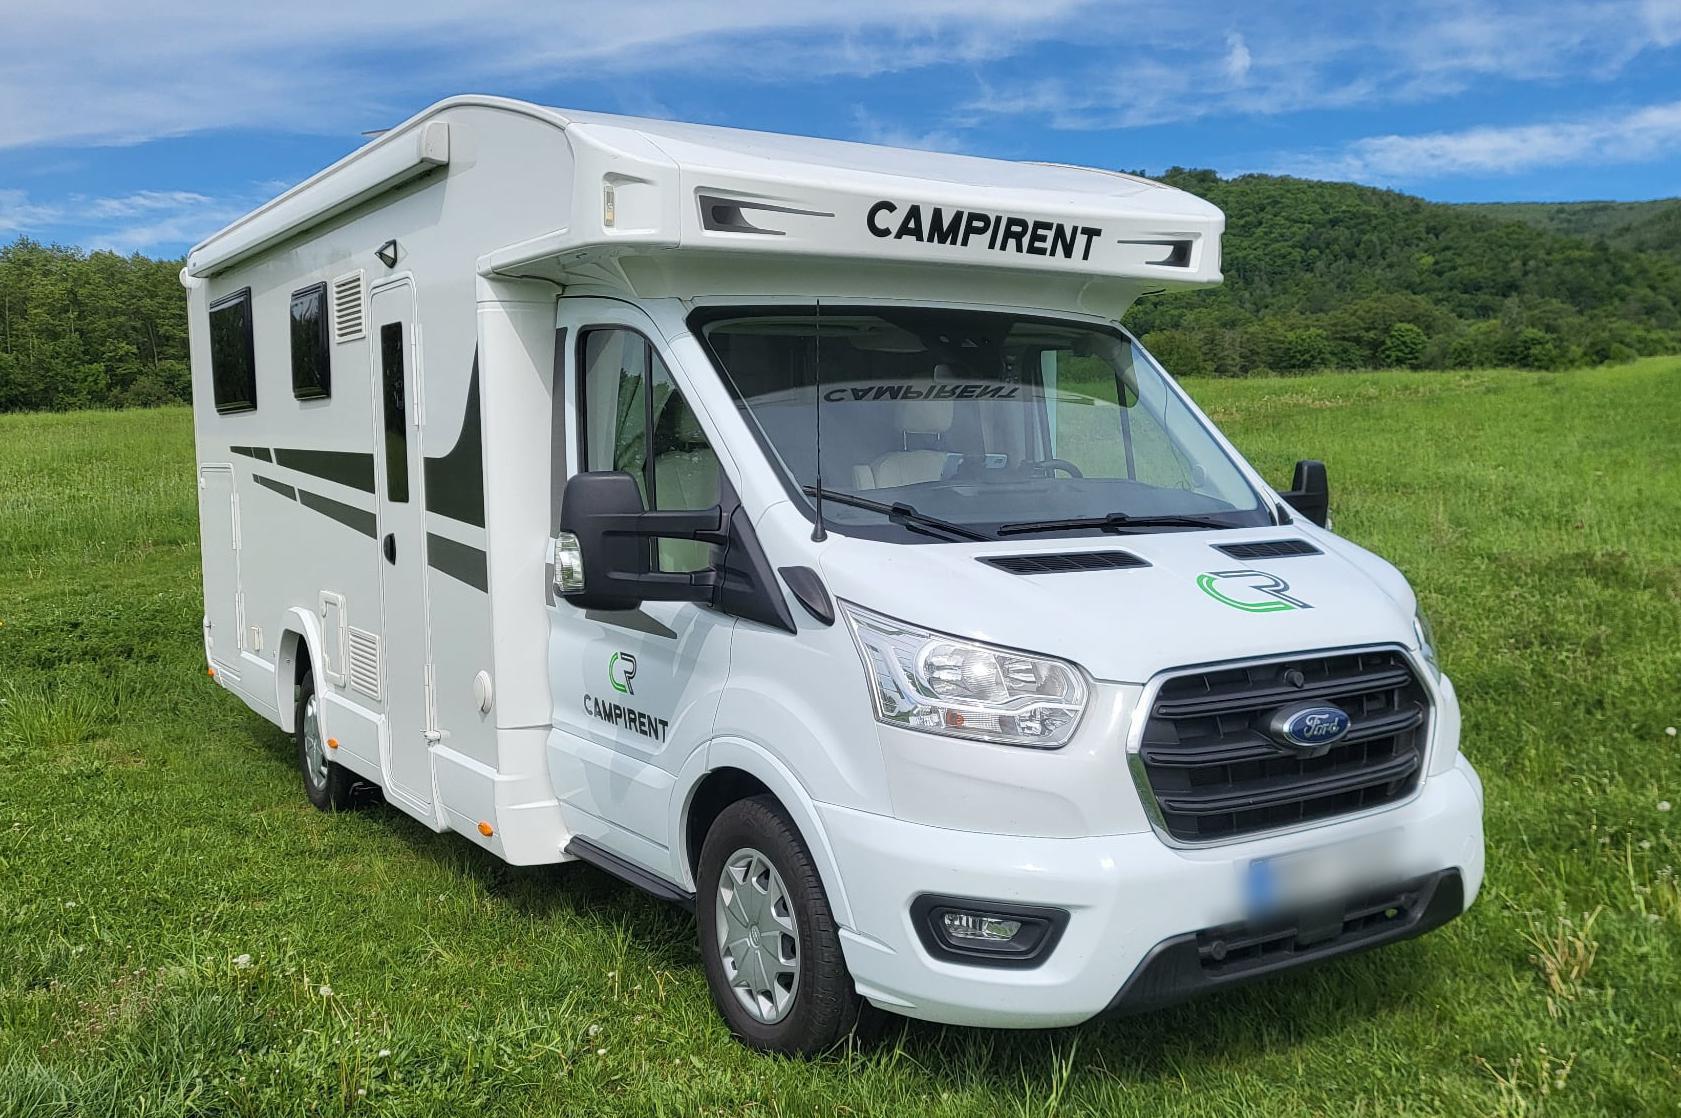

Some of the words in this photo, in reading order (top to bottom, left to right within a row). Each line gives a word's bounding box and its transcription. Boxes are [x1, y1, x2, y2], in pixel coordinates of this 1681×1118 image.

[866, 200, 1102, 261] CAMPIRENT
[583, 694, 669, 743] CAMPIRENT
[1304, 713, 1340, 738] Ford
